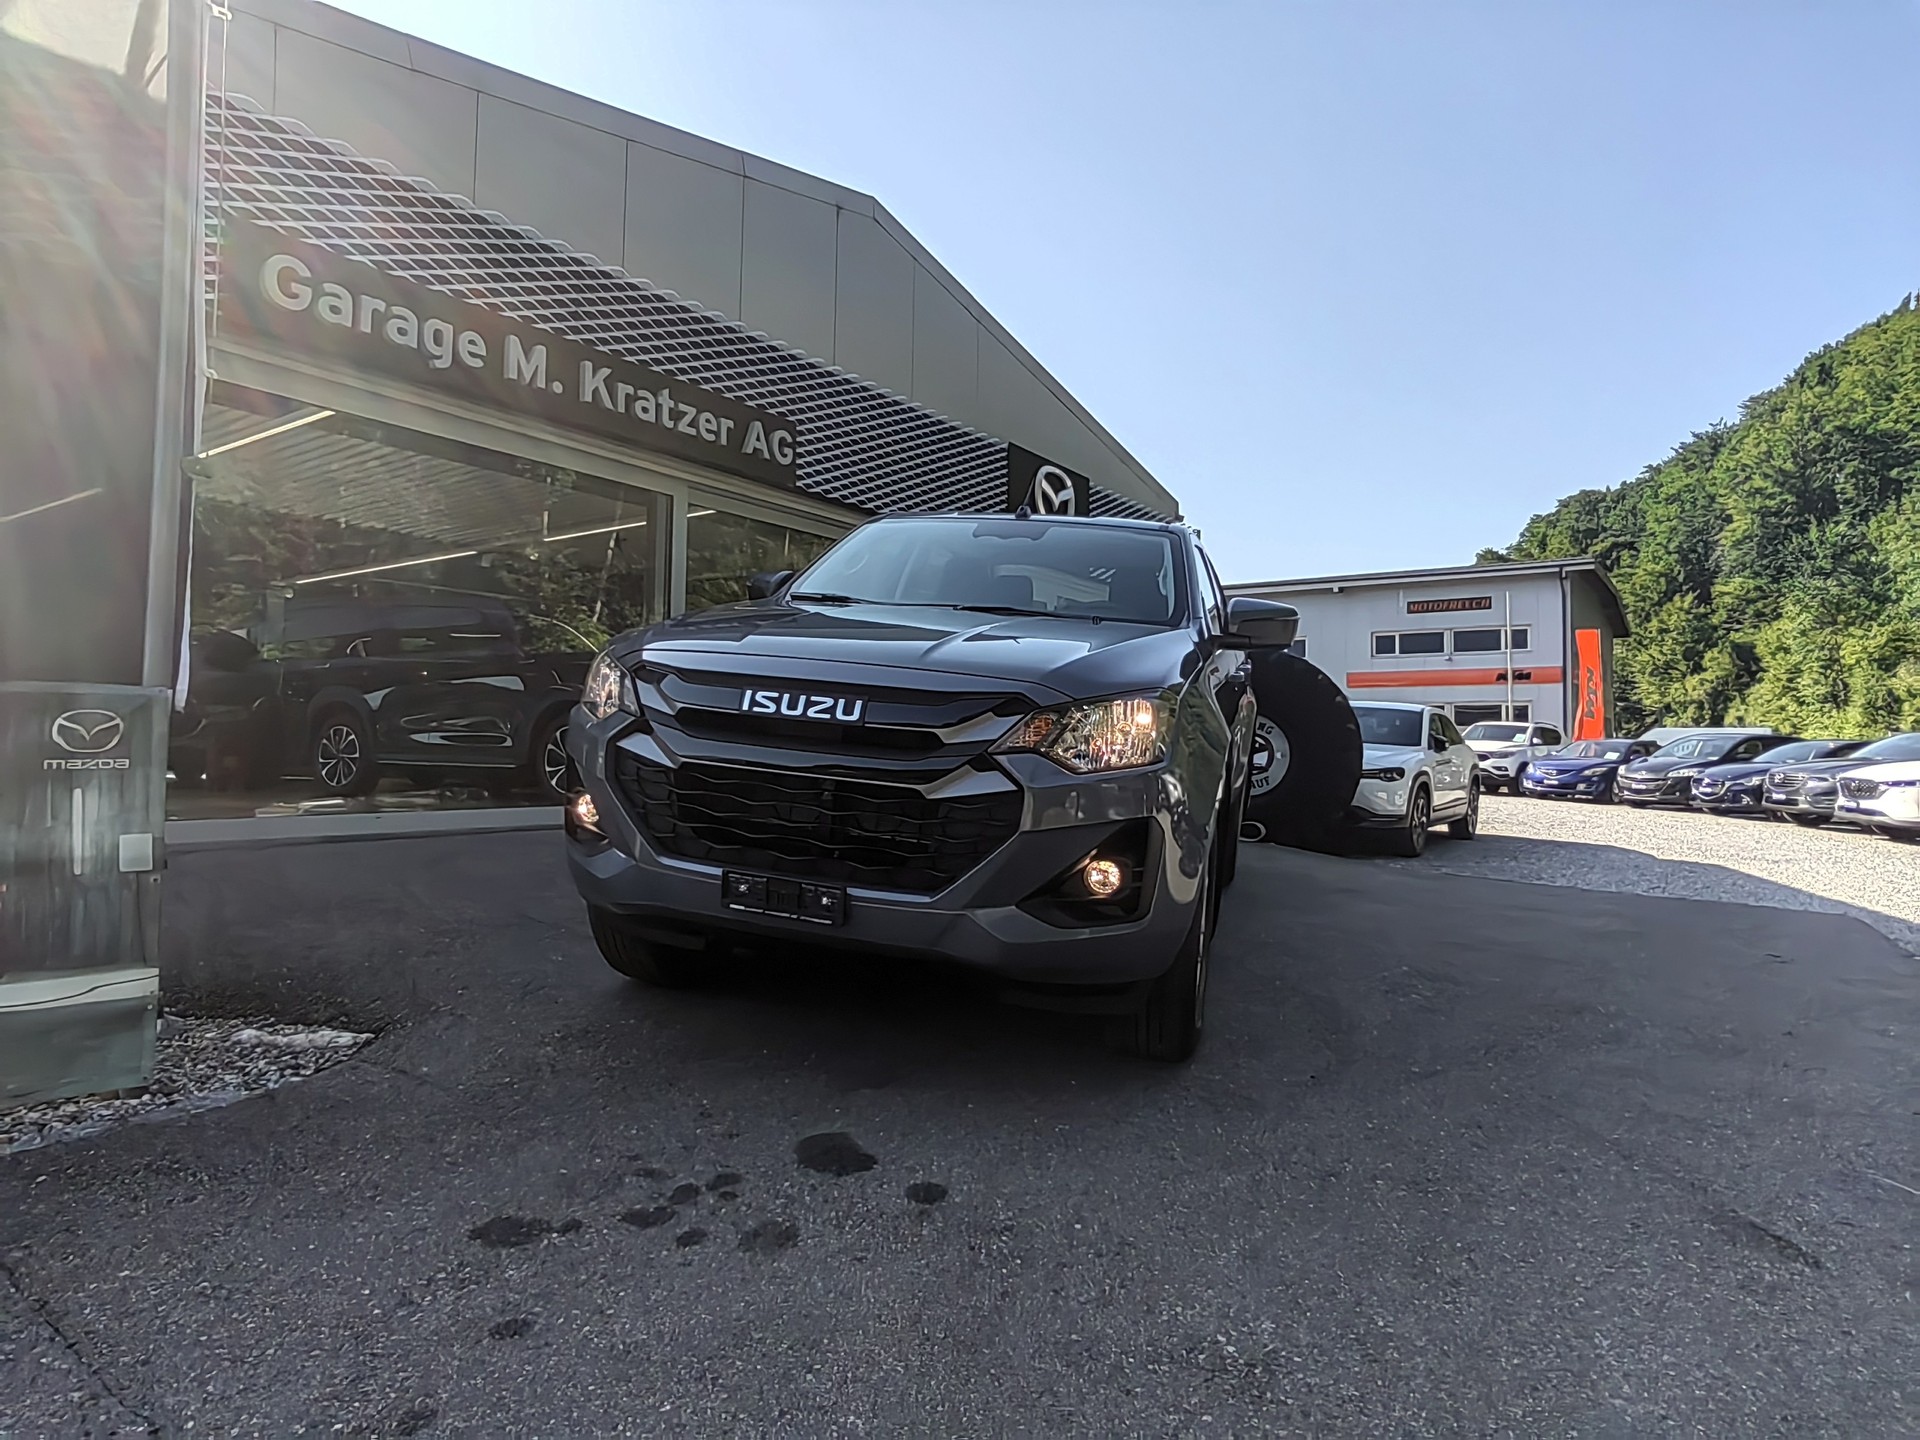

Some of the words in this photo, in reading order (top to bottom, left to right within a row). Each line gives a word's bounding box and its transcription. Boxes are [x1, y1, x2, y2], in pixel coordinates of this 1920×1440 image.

[260, 254, 488, 370] Garage
[503, 334, 564, 395] M.
[579, 360, 735, 447] Kratzer
[741, 420, 795, 467] AG
[741, 688, 864, 722] ISUZU
